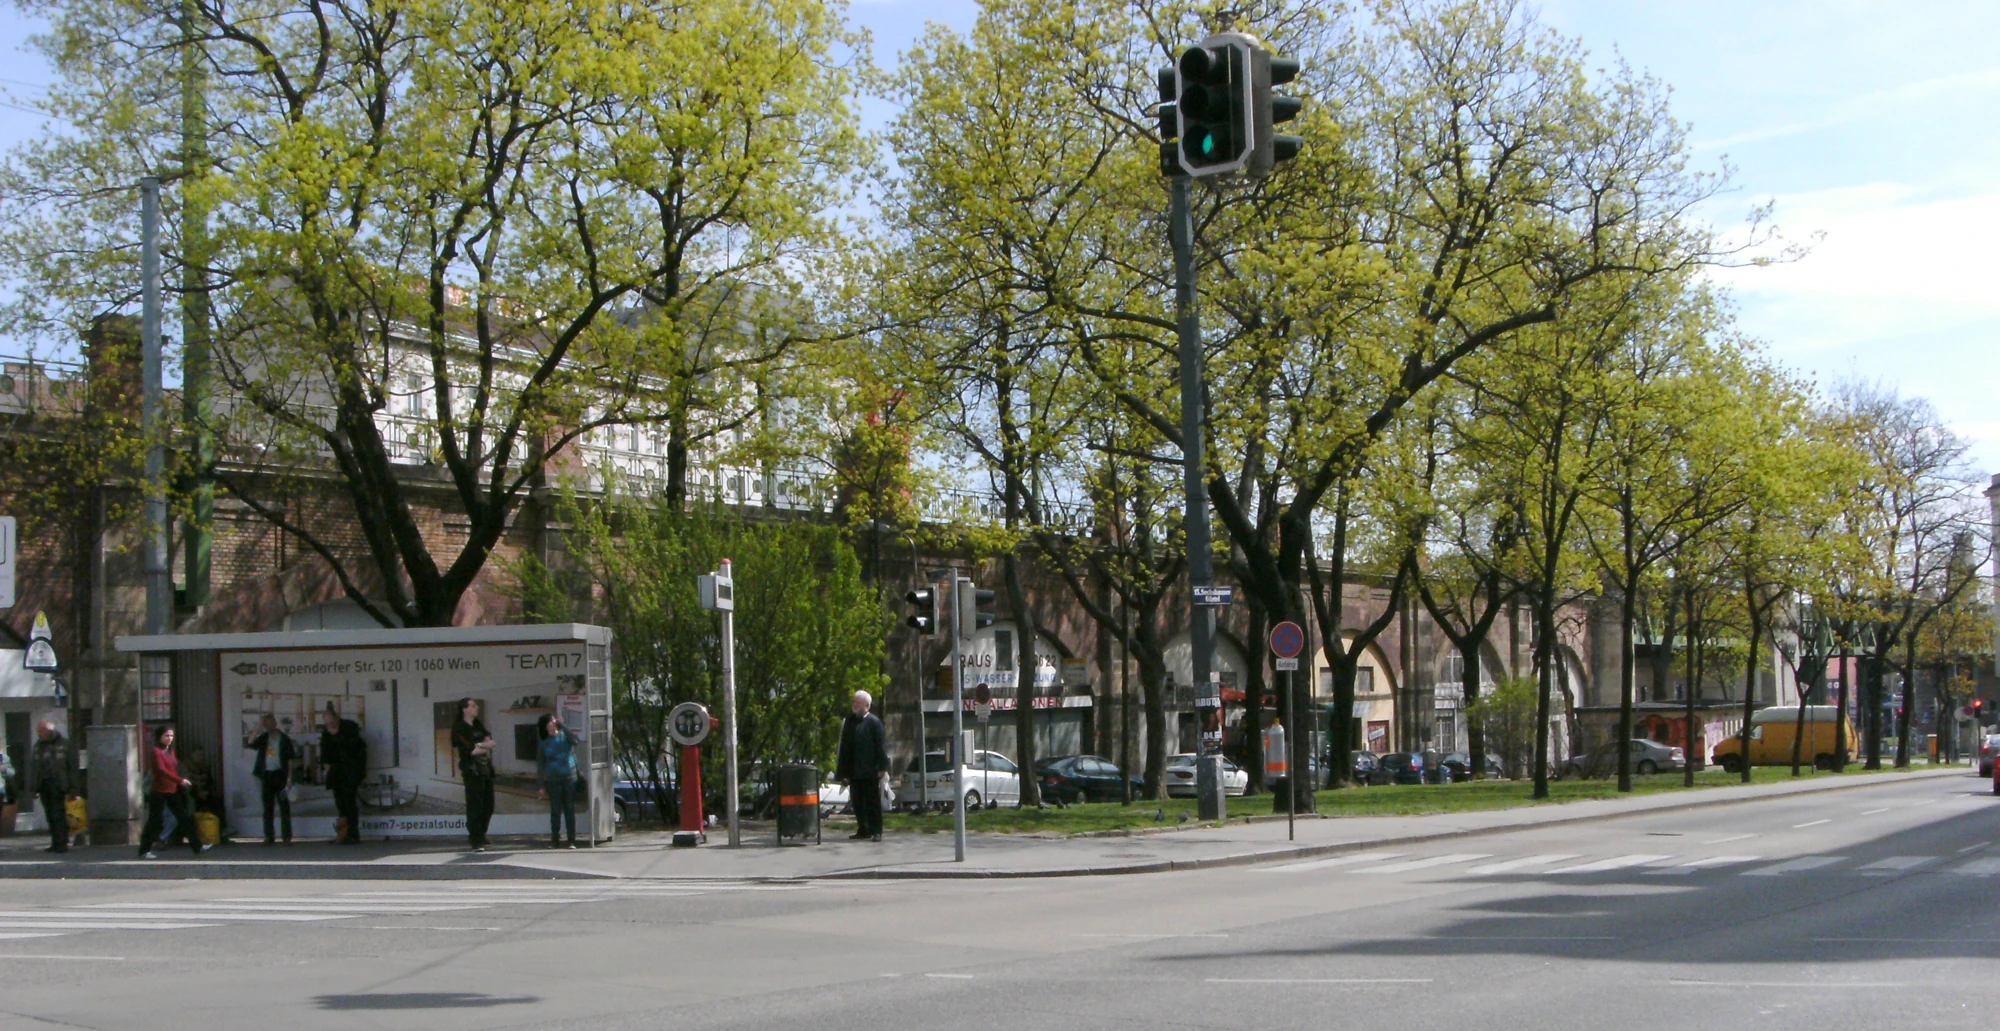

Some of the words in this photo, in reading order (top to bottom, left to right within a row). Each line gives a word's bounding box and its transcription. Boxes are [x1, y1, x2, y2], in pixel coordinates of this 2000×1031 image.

[259, 662, 350, 677] Gumpendorfer
[354, 660, 376, 673] Str.
[381, 659, 402, 672] 120
[415, 659, 444, 671] 1060
[448, 657, 480, 670] Wien
[952, 654, 991, 668] RAUS
